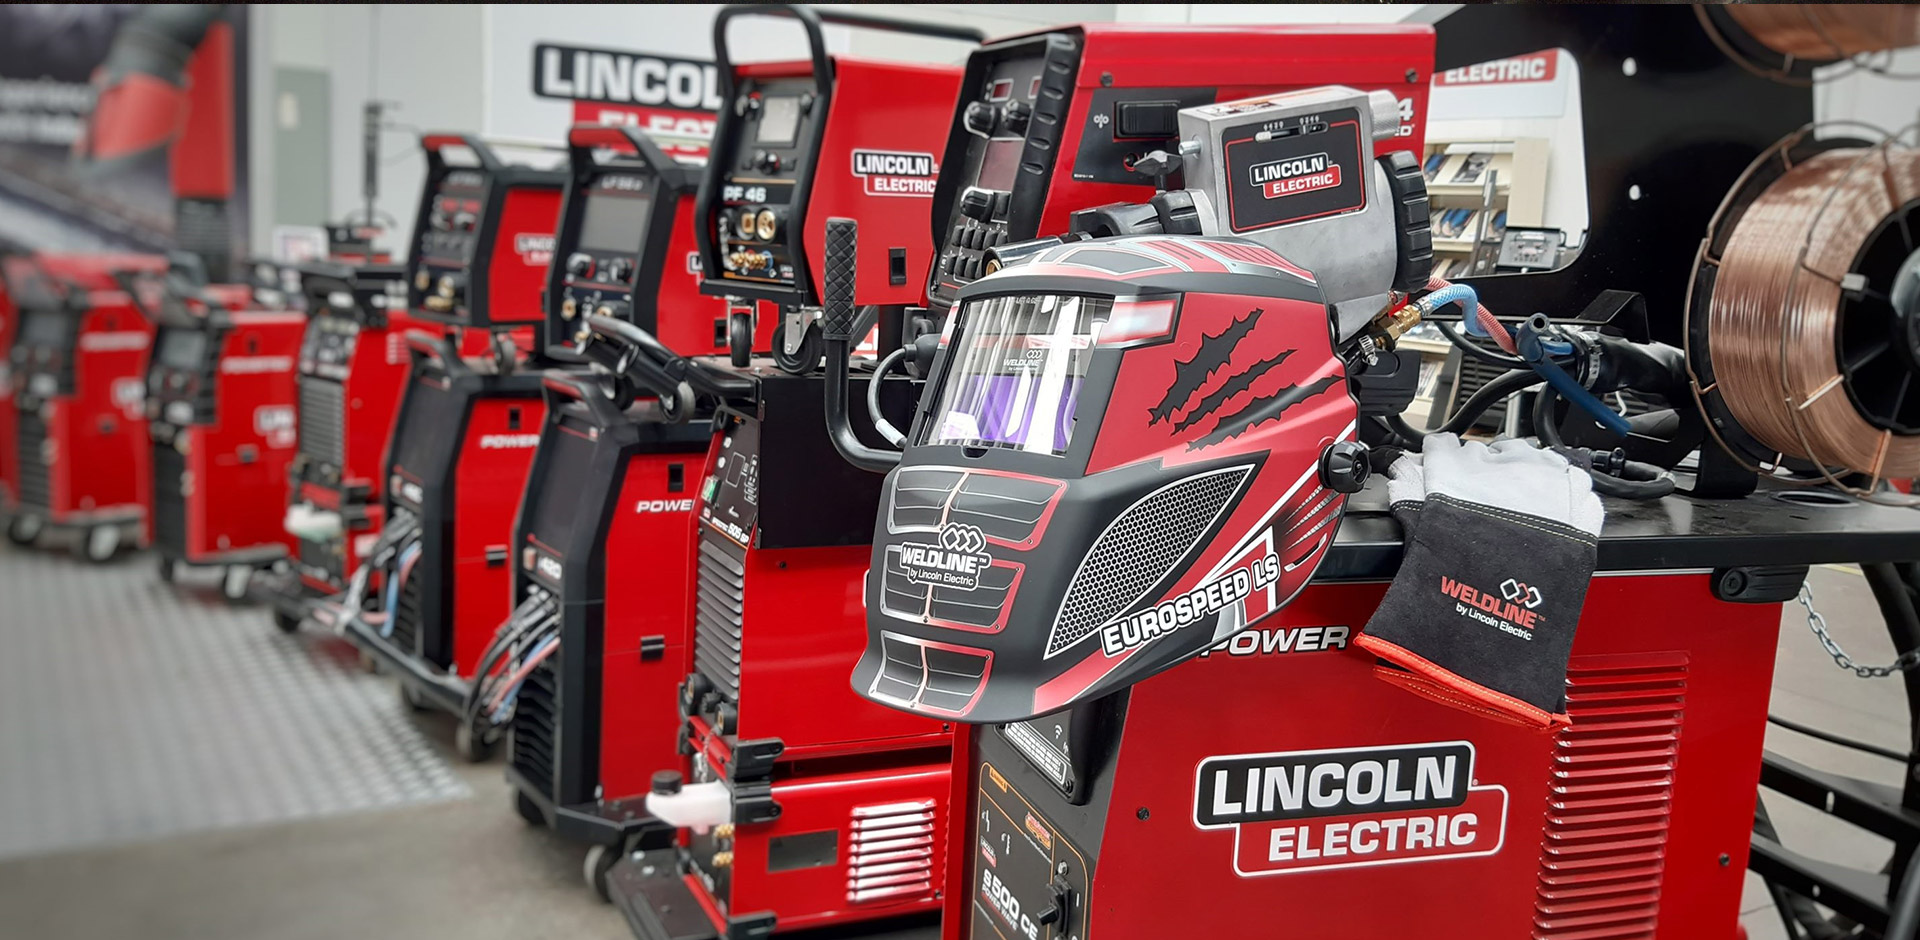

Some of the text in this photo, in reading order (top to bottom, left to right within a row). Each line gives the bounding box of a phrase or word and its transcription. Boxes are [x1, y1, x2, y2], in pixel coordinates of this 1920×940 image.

[1444, 58, 1546, 84] ELECTRIC
[856, 154, 929, 175] LINCOLN
[1254, 157, 1324, 183] LINCOLN
[723, 185, 767, 202] PF 46
[874, 177, 937, 193] ELECTRIC
[1273, 173, 1333, 194] ELECTRIC
[480, 434, 541, 450] POWER
[910, 568, 974, 586] by Lincoln Electric
[1102, 554, 1279, 655] EUROSPEED LS
[1456, 602, 1533, 641] by Lincoln Electric
[1212, 755, 1457, 816] LINCOLN
[1268, 812, 1478, 862] ELECTRIC
[983, 868, 1020, 920] S500
[1021, 913, 1038, 940] CE
